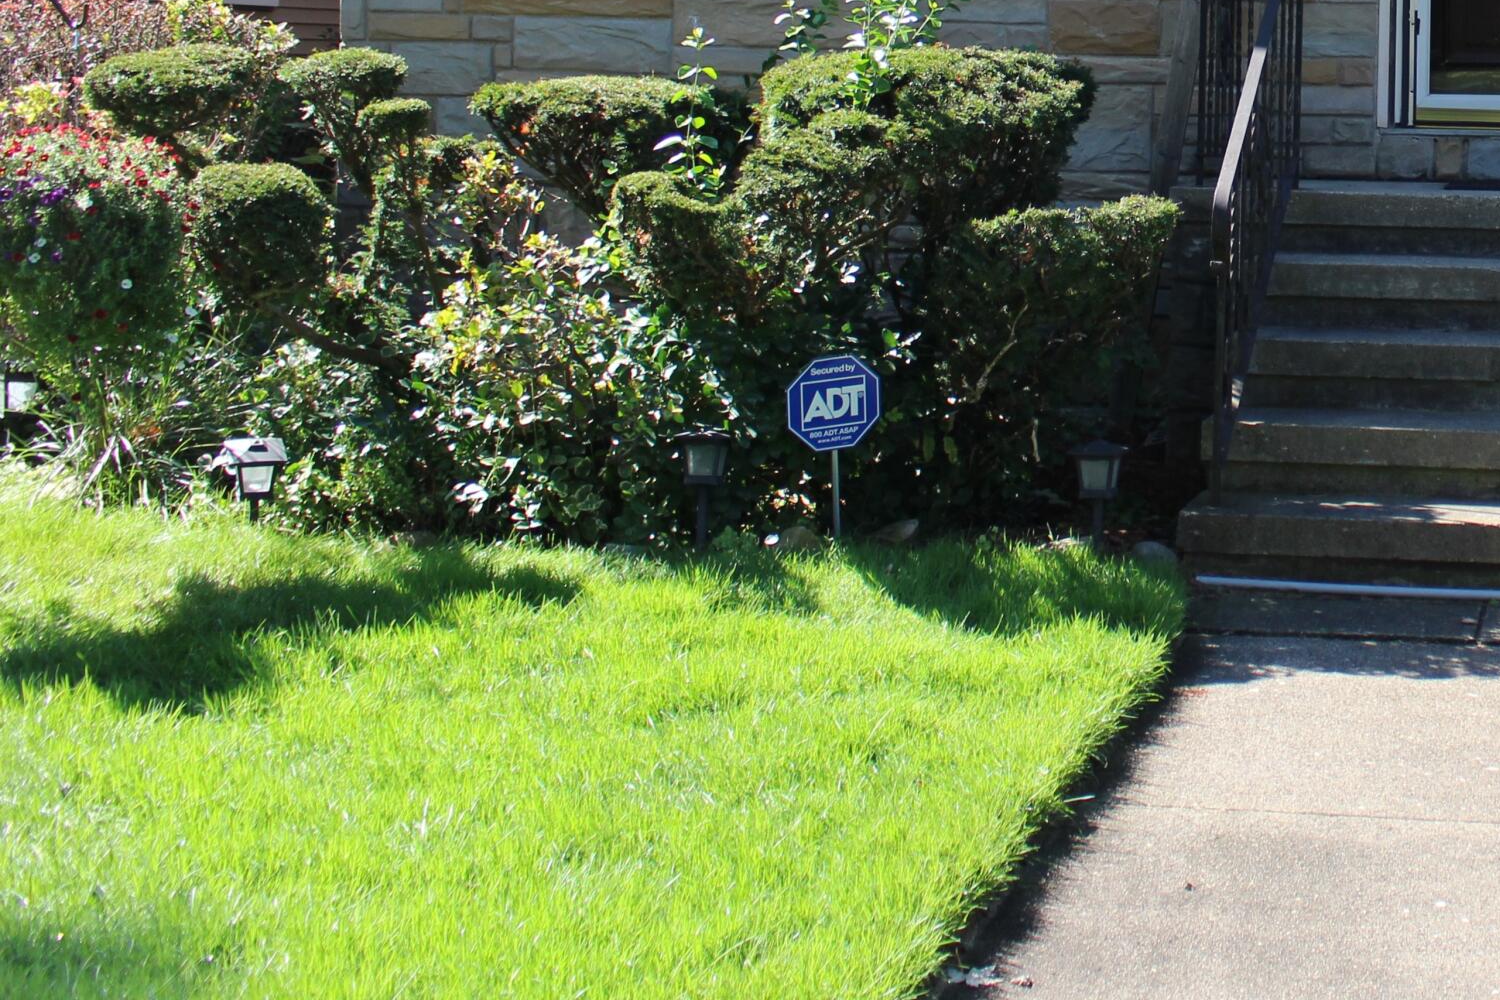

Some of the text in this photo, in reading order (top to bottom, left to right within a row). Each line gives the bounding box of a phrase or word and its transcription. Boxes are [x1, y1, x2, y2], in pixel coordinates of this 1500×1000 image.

[810, 364, 855, 376] Secured by
[803, 384, 865, 423] ADT
